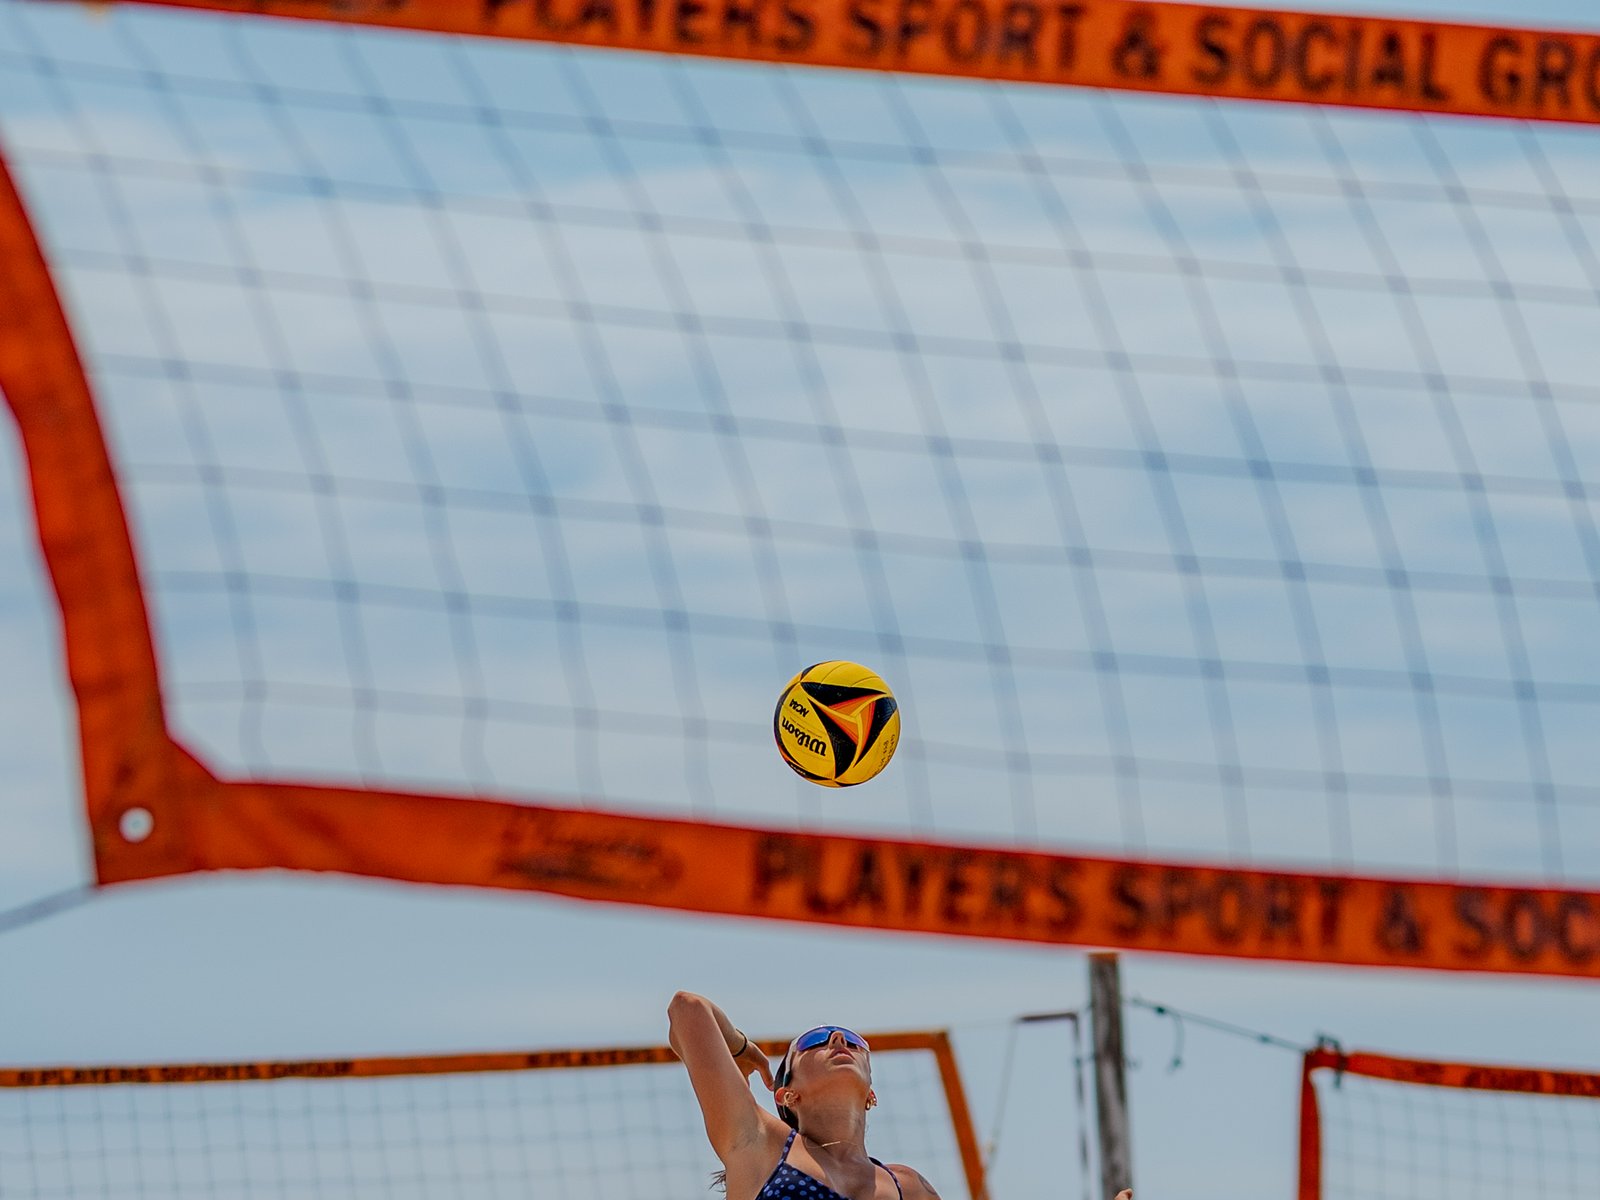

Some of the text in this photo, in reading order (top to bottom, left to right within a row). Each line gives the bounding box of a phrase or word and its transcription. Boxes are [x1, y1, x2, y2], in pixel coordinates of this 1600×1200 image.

[842, 0, 1086, 70] SPORT
[1111, 8, 1167, 78] &
[1192, 15, 1447, 102] SOCIAL
[781, 716, 827, 757] Wilson
[789, 698, 810, 718] NCAA
[754, 833, 1082, 933] PLAYERS
[1108, 861, 1354, 950] SPORT
[1374, 885, 1428, 955] &
